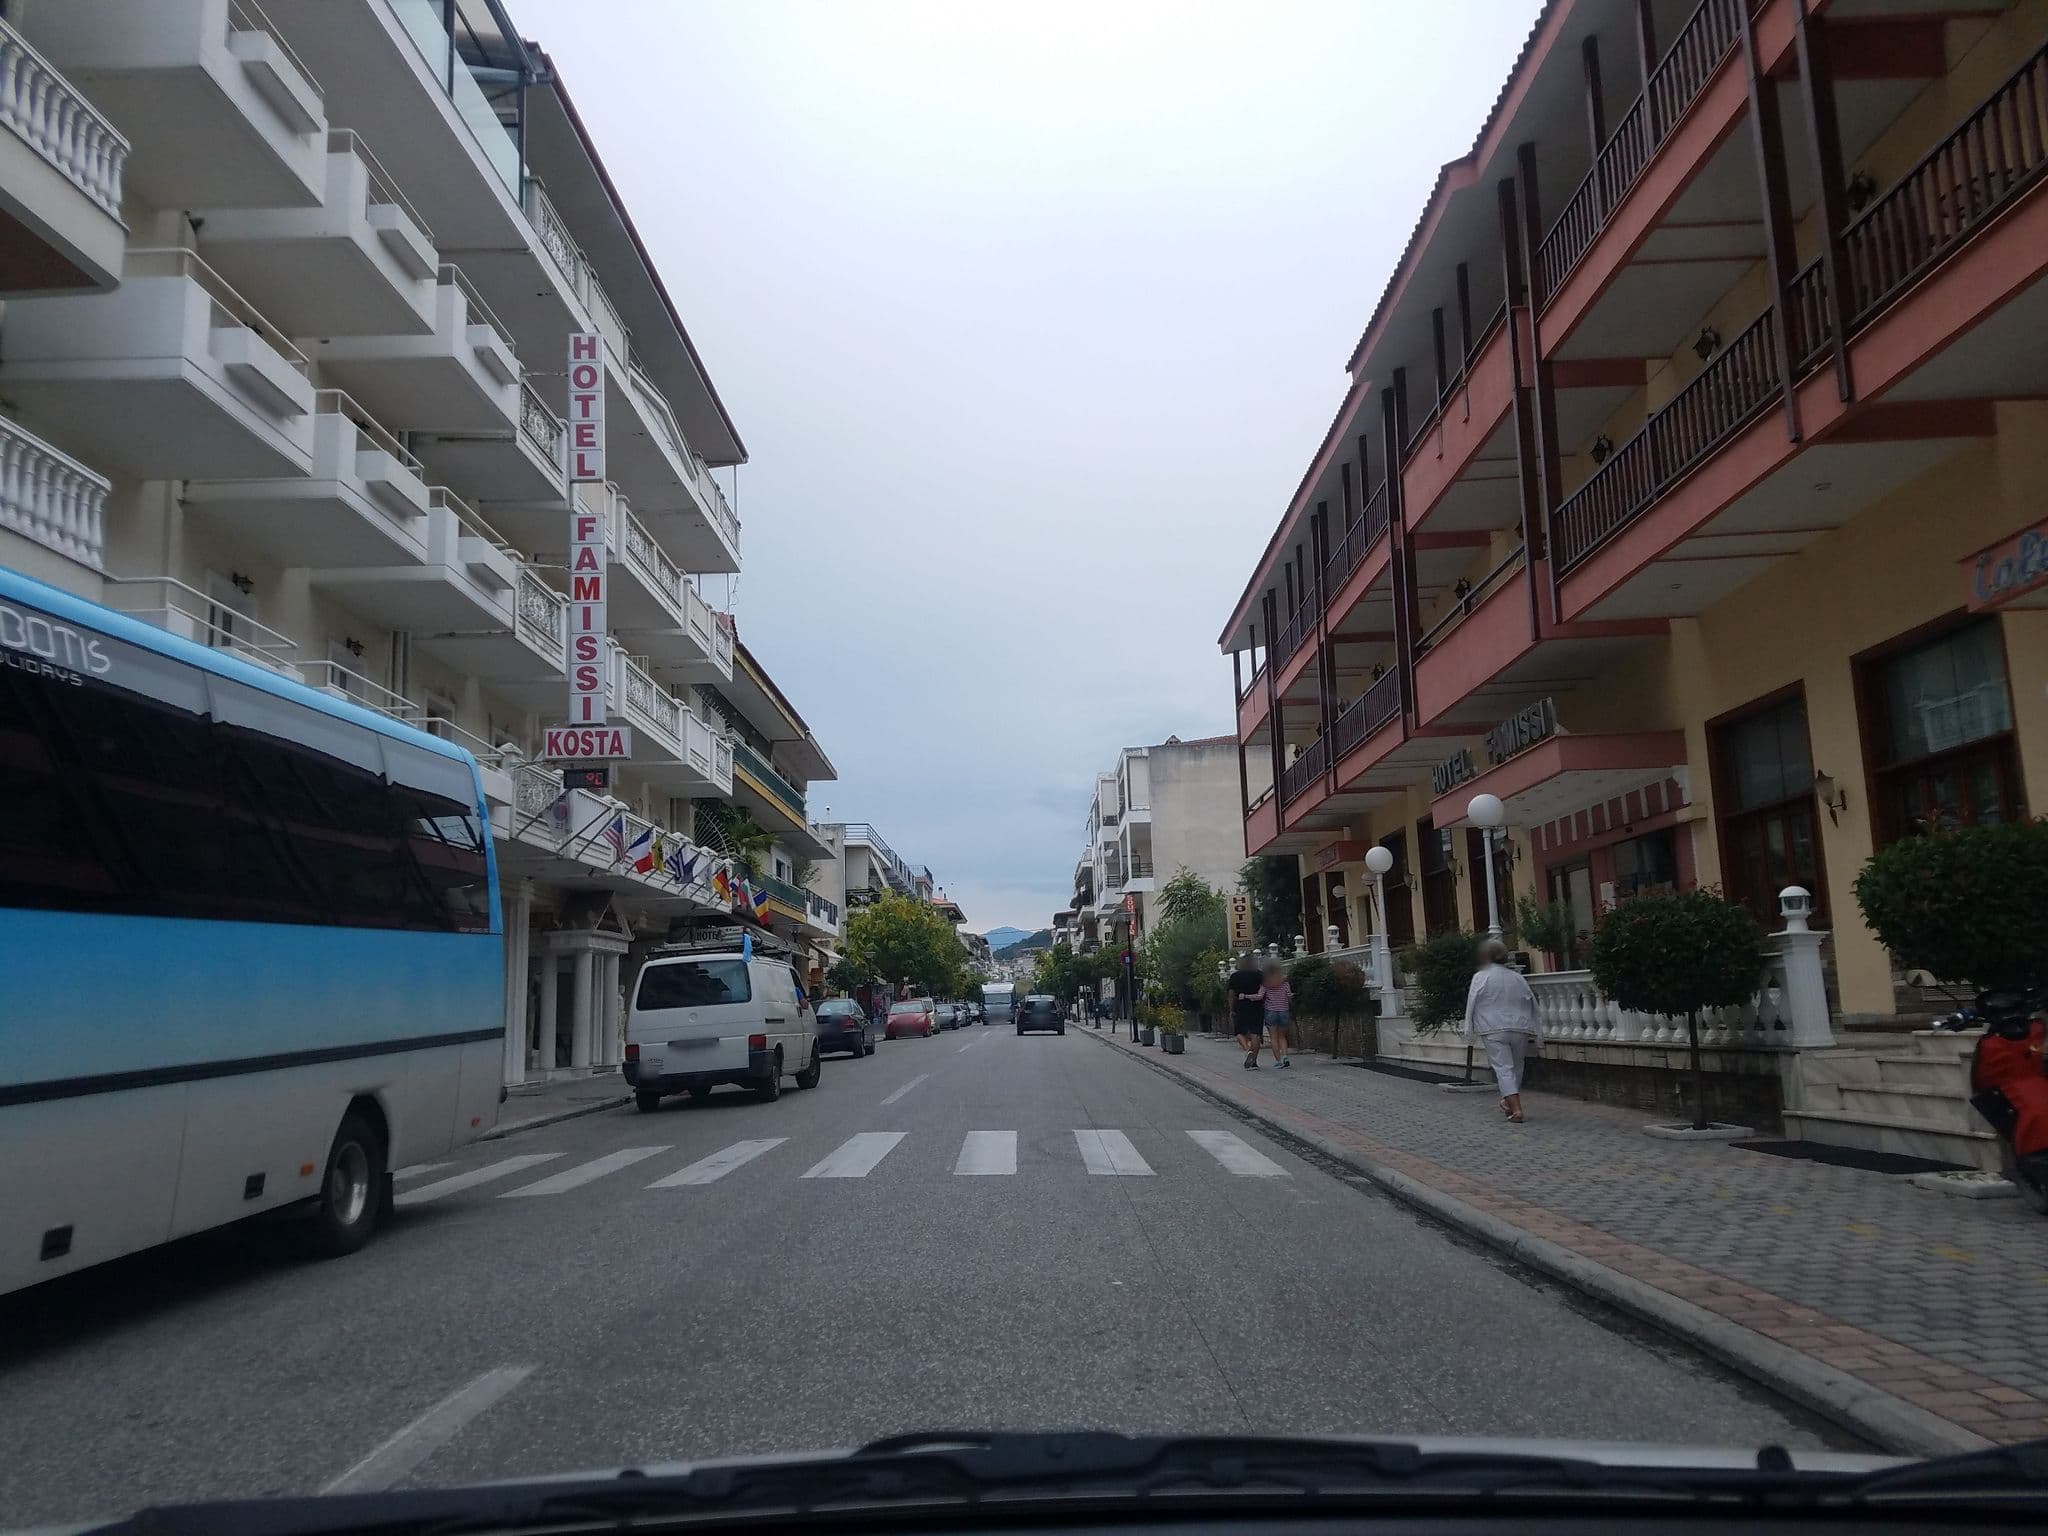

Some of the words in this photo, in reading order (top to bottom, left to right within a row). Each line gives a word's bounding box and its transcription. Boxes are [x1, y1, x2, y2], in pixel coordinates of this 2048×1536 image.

[573, 336, 598, 477] HOTEL
[574, 517, 600, 721] FAMISSI
[547, 730, 625, 756] KOSTA
[1431, 746, 1474, 794] HOTEL
[1232, 897, 1248, 938] HOTEL
